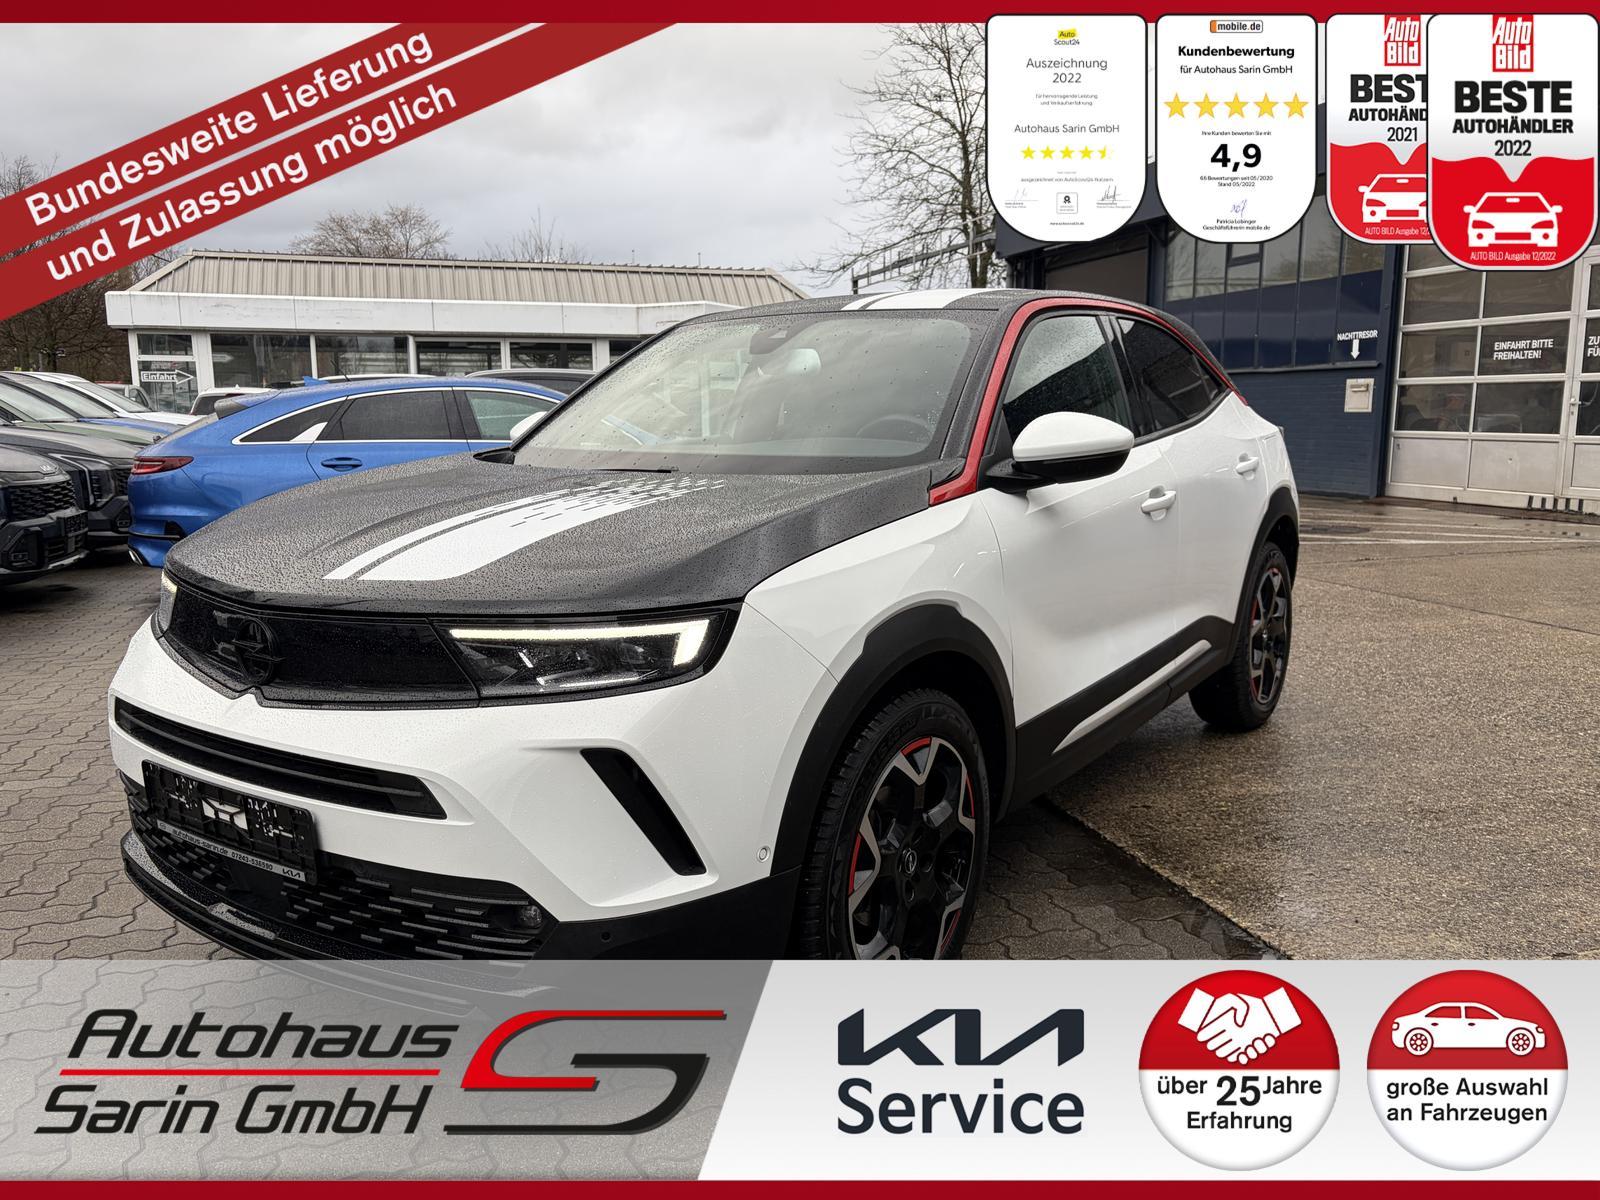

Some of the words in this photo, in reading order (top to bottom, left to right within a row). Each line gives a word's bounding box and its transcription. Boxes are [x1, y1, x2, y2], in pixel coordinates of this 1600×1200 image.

[1337, 330, 1378, 341] NACHTTRESOR
[1588, 336, 1600, 345] ZU
[1494, 340, 1531, 350] EINFAHRT
[1531, 339, 1554, 349] BITTE
[1493, 350, 1542, 360] FREIHALTEN!
[1587, 345, 1600, 357] FÜ
